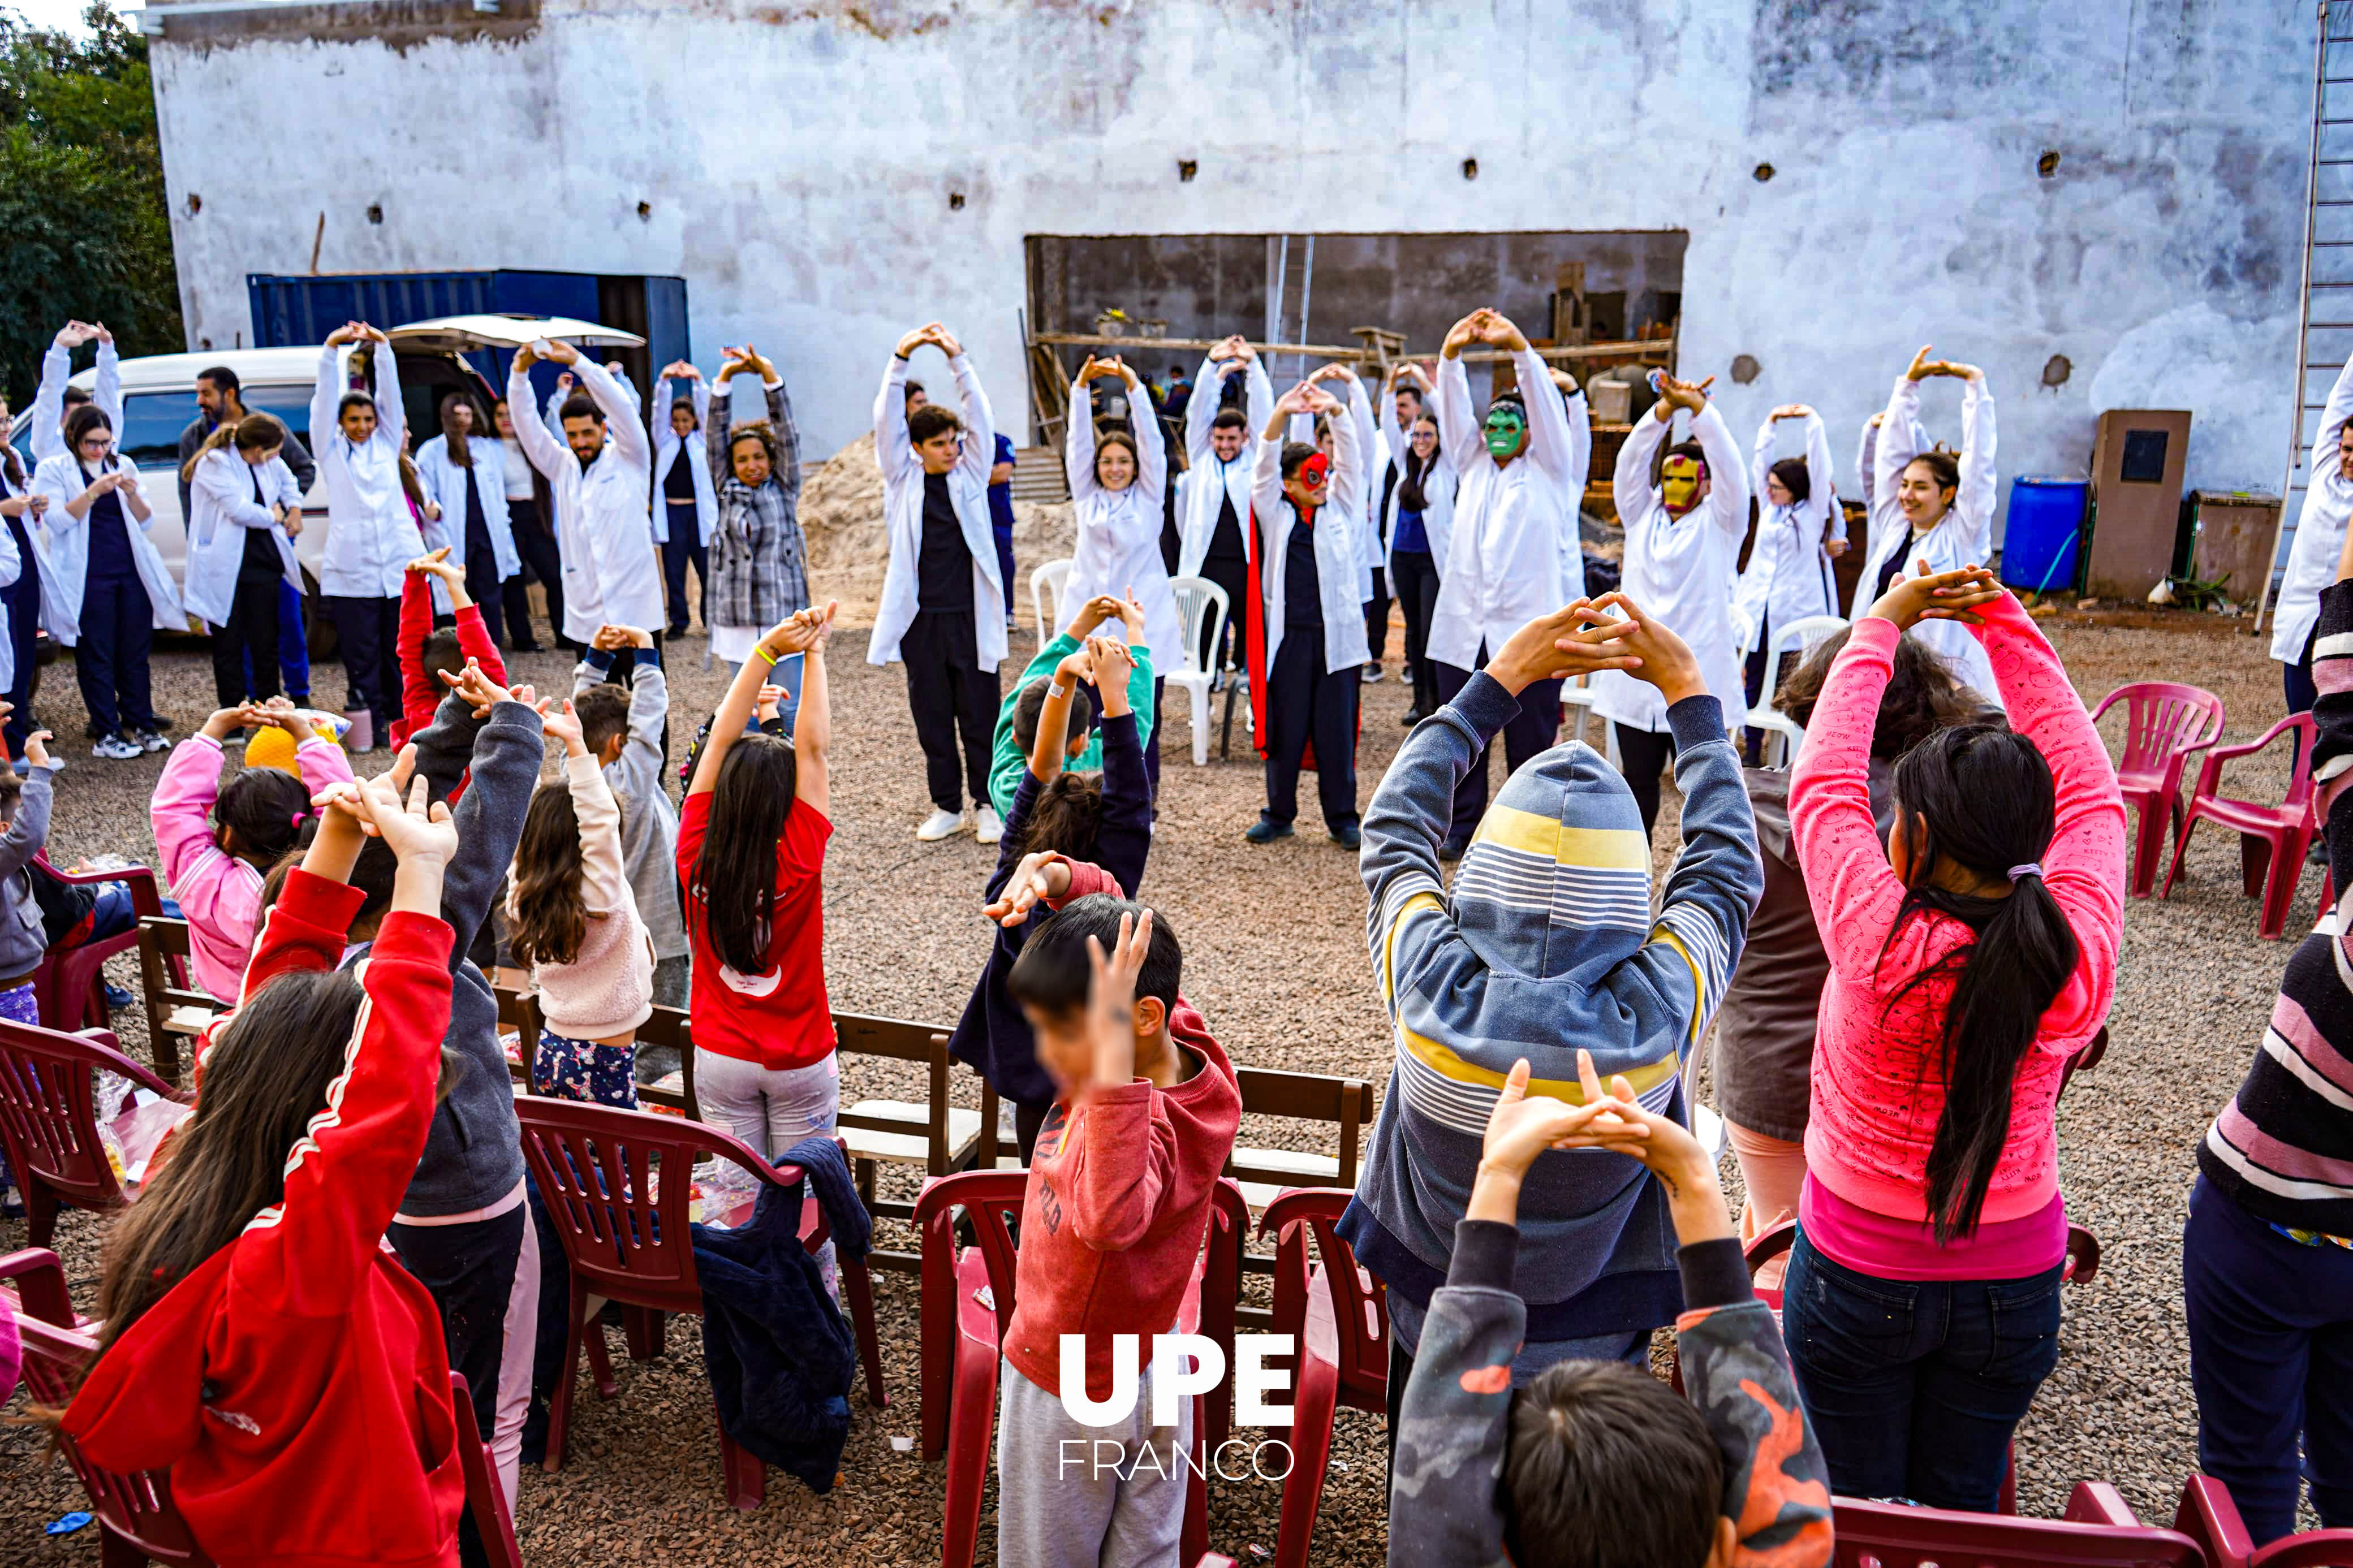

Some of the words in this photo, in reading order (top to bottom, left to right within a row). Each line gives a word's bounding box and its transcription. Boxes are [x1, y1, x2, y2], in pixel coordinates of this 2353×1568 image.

[2022, 697, 2034, 710] CAT
[2028, 697, 2048, 715] KITTY
[2051, 700, 2073, 711] MEOW
[1826, 731, 1850, 740] MEOW
[1835, 824, 1856, 833] MEOW
[1829, 869, 1838, 882] CAT
[1846, 868, 1865, 884] KITTY
[1863, 899, 1876, 911] CAT
[1874, 1106, 1900, 1118] MEOW
[2002, 1168, 2021, 1181] KITTY
